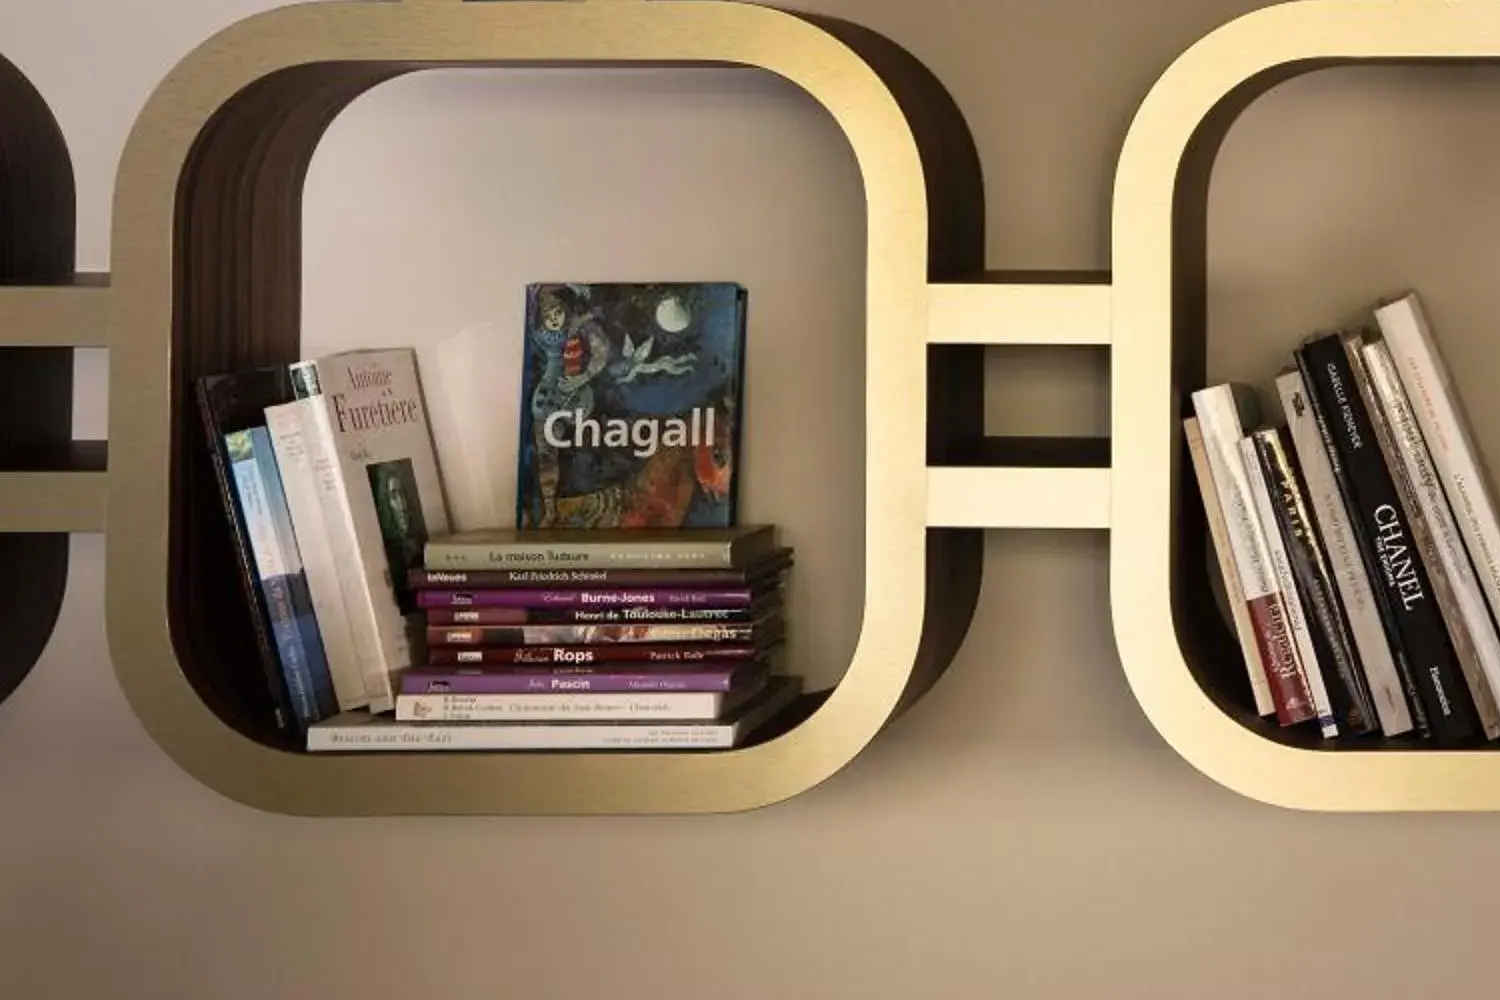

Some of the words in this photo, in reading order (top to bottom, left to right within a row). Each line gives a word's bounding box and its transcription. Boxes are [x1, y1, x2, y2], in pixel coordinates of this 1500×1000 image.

[543, 407, 716, 457] Chagall
[489, 552, 503, 561] La
[505, 552, 544, 561] maison
[1371, 501, 1427, 612] CHANEL
[582, 592, 655, 603] Burne-Jones
[553, 648, 593, 663] Rops
